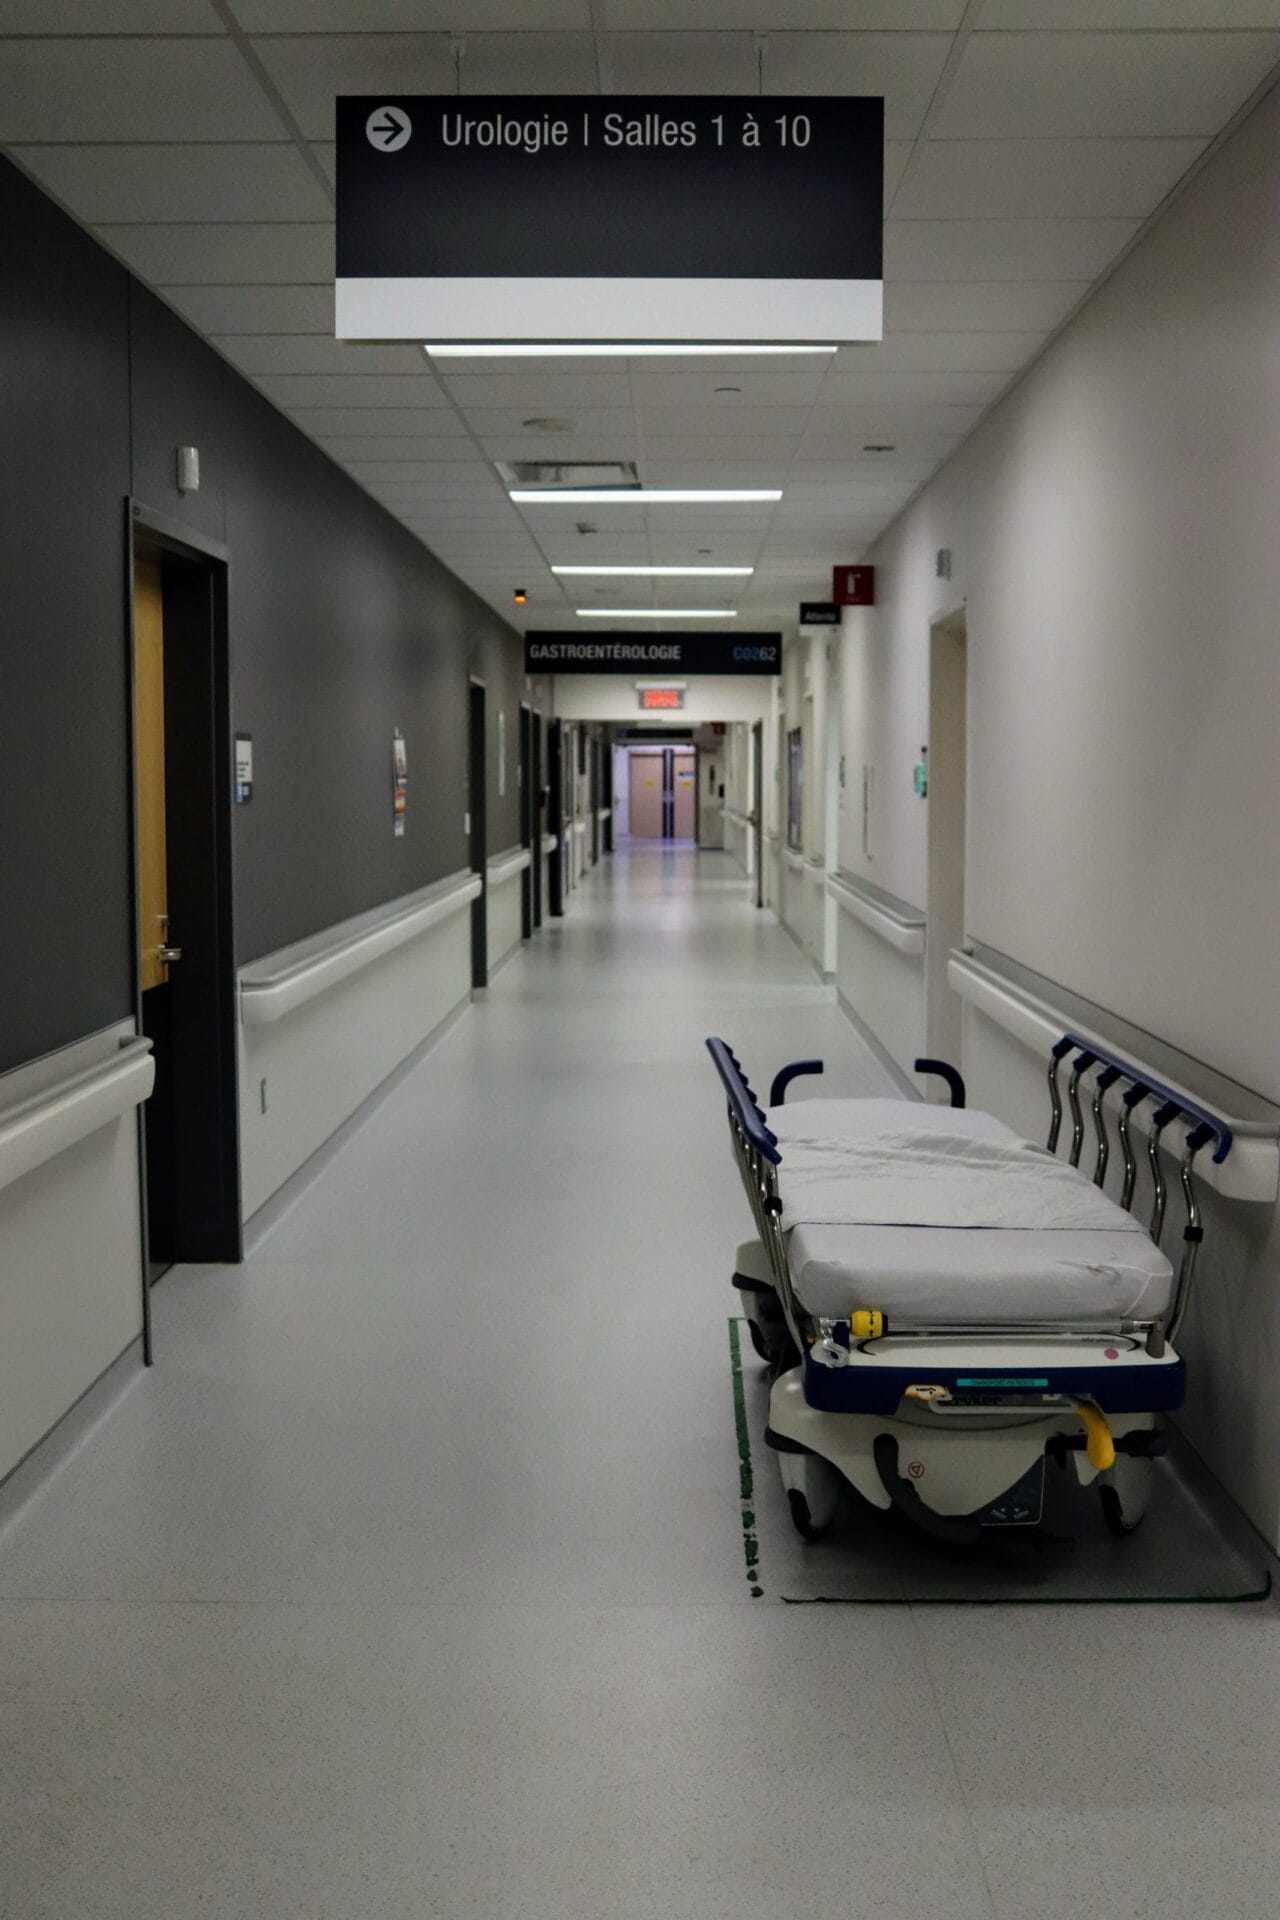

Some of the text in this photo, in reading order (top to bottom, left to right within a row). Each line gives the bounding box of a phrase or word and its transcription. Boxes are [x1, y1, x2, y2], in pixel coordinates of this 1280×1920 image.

[441, 113, 569, 153] Urologie
[603, 113, 697, 147] Salles
[711, 114, 724, 146] 1
[742, 113, 761, 147] à
[775, 114, 811, 147] 10
[529, 643, 682, 661] GASTROENTÉROLOGIE
